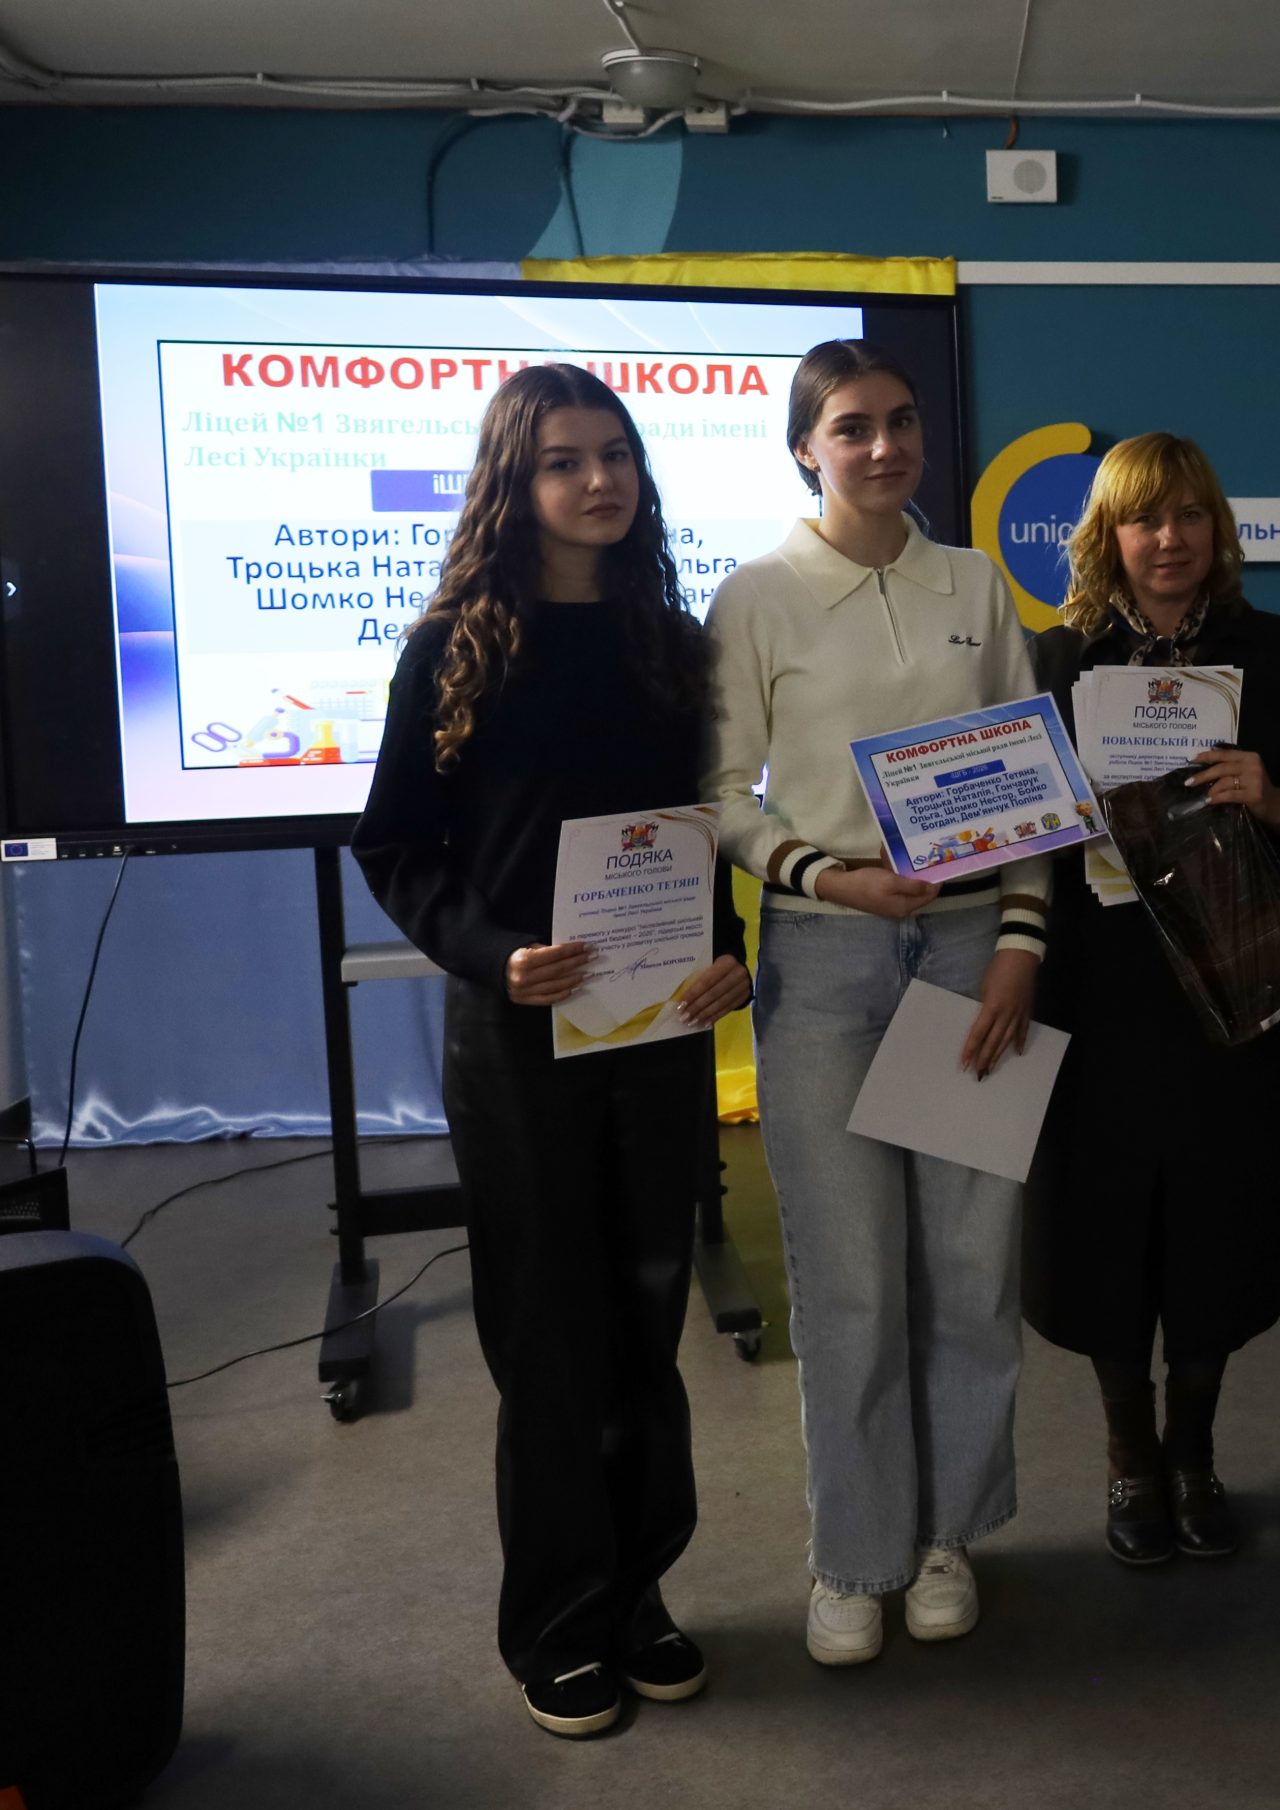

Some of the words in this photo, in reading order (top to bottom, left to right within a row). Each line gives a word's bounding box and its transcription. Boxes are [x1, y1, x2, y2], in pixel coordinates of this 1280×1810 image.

[222, 353, 557, 391] КОМФОРТН
[587, 361, 769, 396] ШКОЛА
[181, 411, 269, 436] Ліцей
[276, 411, 323, 433] №1
[336, 413, 480, 435] Звягельсь
[702, 418, 768, 438] імені
[184, 446, 247, 467] Лесі
[254, 446, 387, 473] Українки
[274, 524, 400, 551] Автори:
[1010, 514, 1074, 545] unic
[226, 556, 361, 584] Троцька
[372, 555, 441, 577] Ната
[677, 557, 738, 574] льга
[257, 587, 374, 610] Шомко
[386, 586, 424, 609] Не
[1134, 706, 1197, 720] ПОДЯКА
[886, 733, 978, 764] КОМФОРТНА
[979, 720, 1032, 740] ШКОЛА
[1102, 736, 1187, 745] НОВАКІВСЬКІЙ
[1191, 738, 1224, 746] ГАН
[903, 764, 917, 773] №1
[906, 791, 945, 807] Автори:
[946, 776, 1002, 796] Горбаченко
[1002, 768, 1038, 781] Тетяна,
[910, 799, 953, 814] Троцька
[953, 788, 994, 804] Наталія,
[995, 776, 1039, 793] Гончарук
[909, 808, 943, 824] Ольга,
[943, 802, 978, 816] Шомко
[978, 792, 1017, 806] Нестор,
[1017, 784, 1047, 796] Бойко
[920, 816, 960, 831] Богдан,
[1009, 794, 1044, 808] Поліна
[606, 848, 673, 870] ПОДЯКА
[574, 883, 654, 903] ГОРБАЧЕНКО
[658, 876, 699, 891] ТЕТЯНІ
